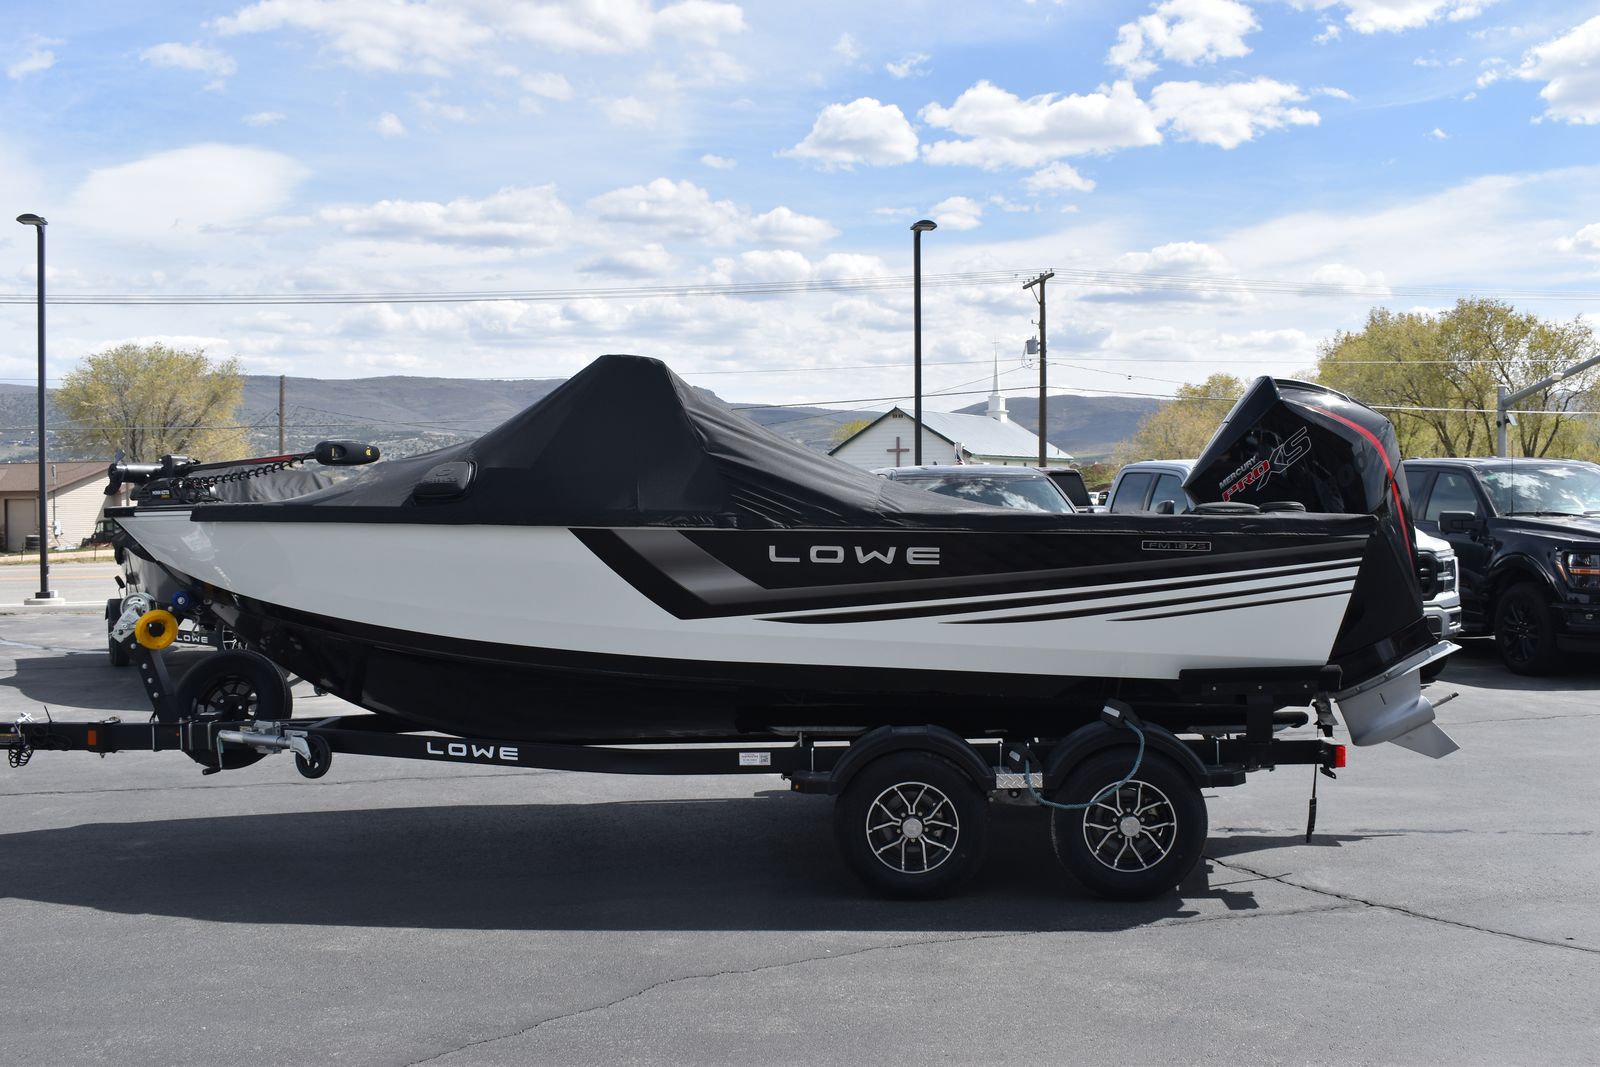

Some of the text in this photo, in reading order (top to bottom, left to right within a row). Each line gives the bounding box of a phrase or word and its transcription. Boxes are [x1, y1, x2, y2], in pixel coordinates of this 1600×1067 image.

[1219, 456, 1257, 489] MERCURY
[1222, 426, 1312, 502] PRO XS
[768, 545, 940, 565] LOWE
[176, 634, 209, 644] LOWE
[426, 741, 519, 761] LOWE
